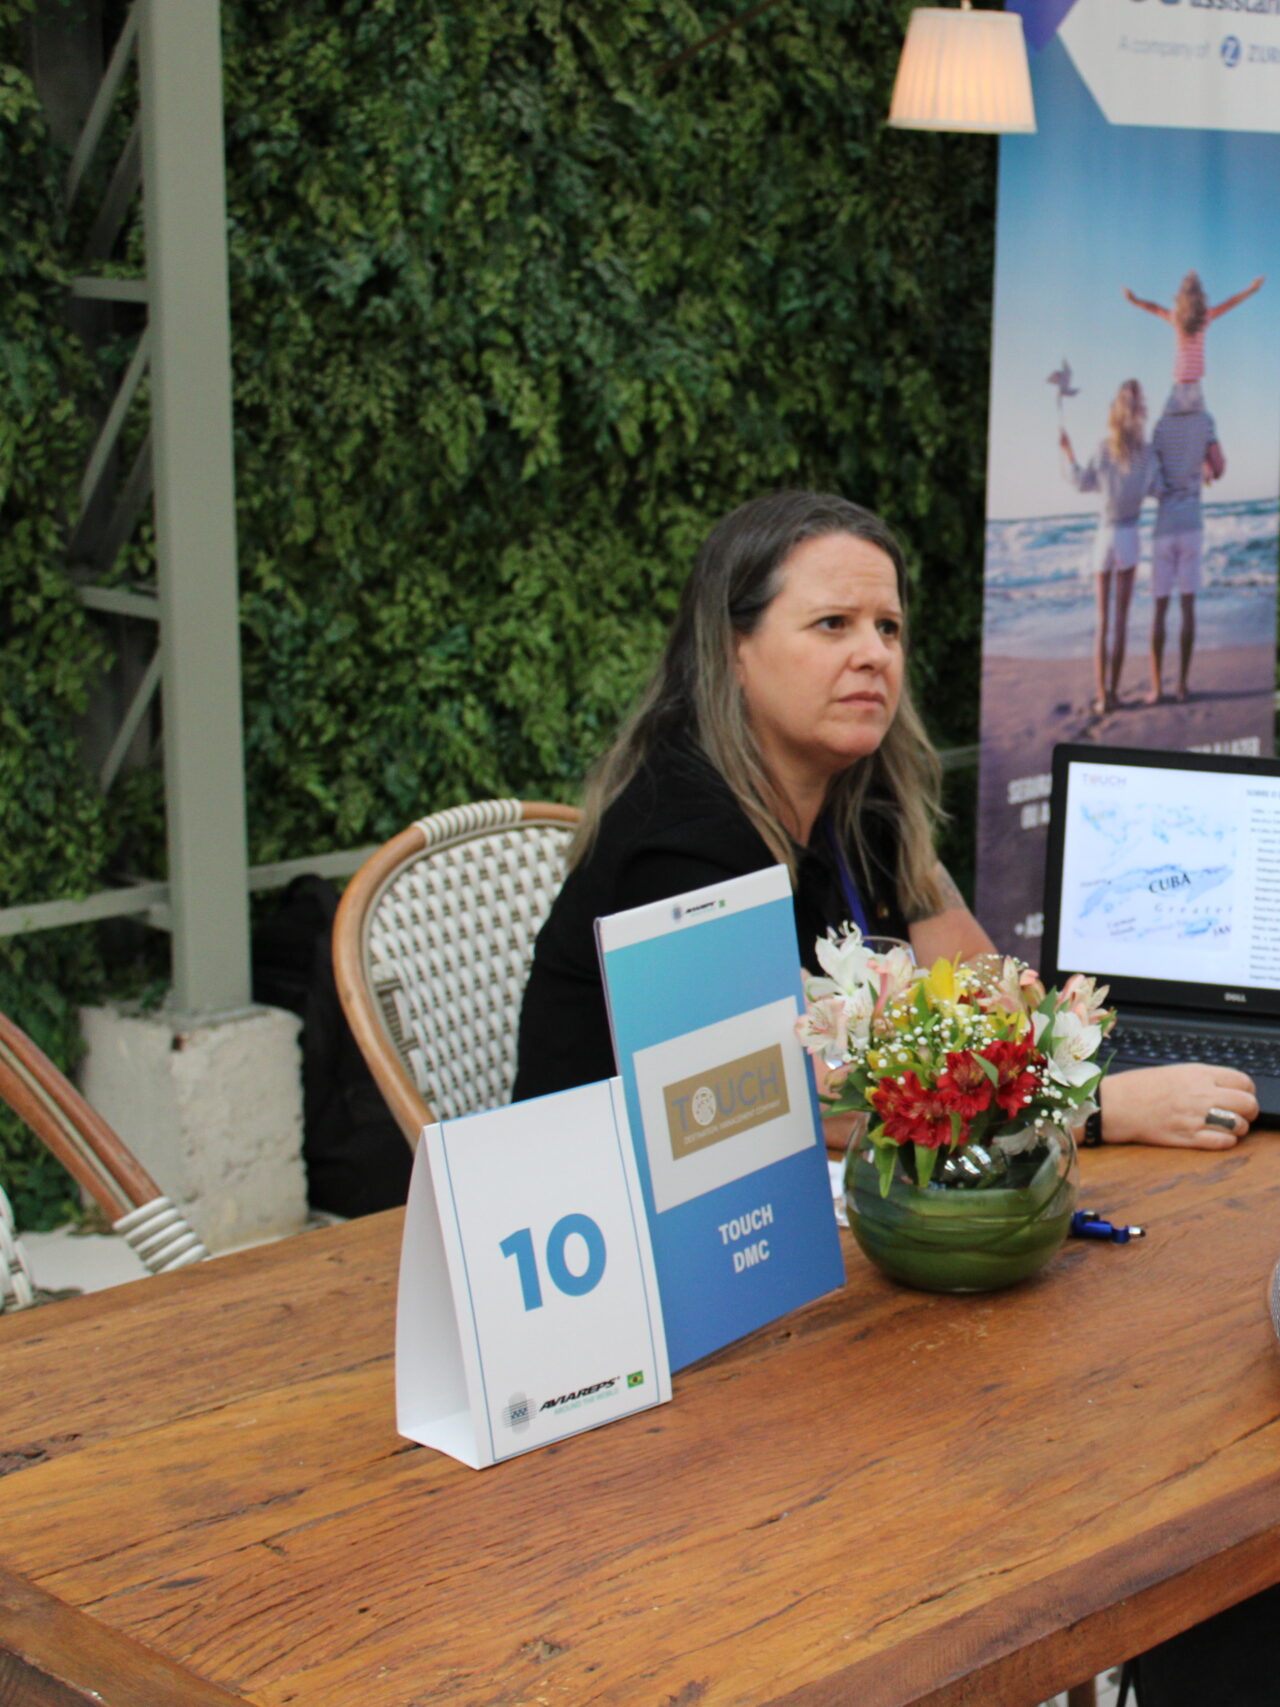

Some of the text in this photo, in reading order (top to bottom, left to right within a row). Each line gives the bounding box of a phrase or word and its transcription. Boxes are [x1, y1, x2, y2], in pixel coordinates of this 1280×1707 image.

[1149, 873, 1191, 893] CUBA
[718, 1203, 774, 1245] TOUCH
[499, 1213, 607, 1312] 10
[733, 1239, 770, 1274] DMC
[539, 1378, 616, 1412] AVIAREPS
